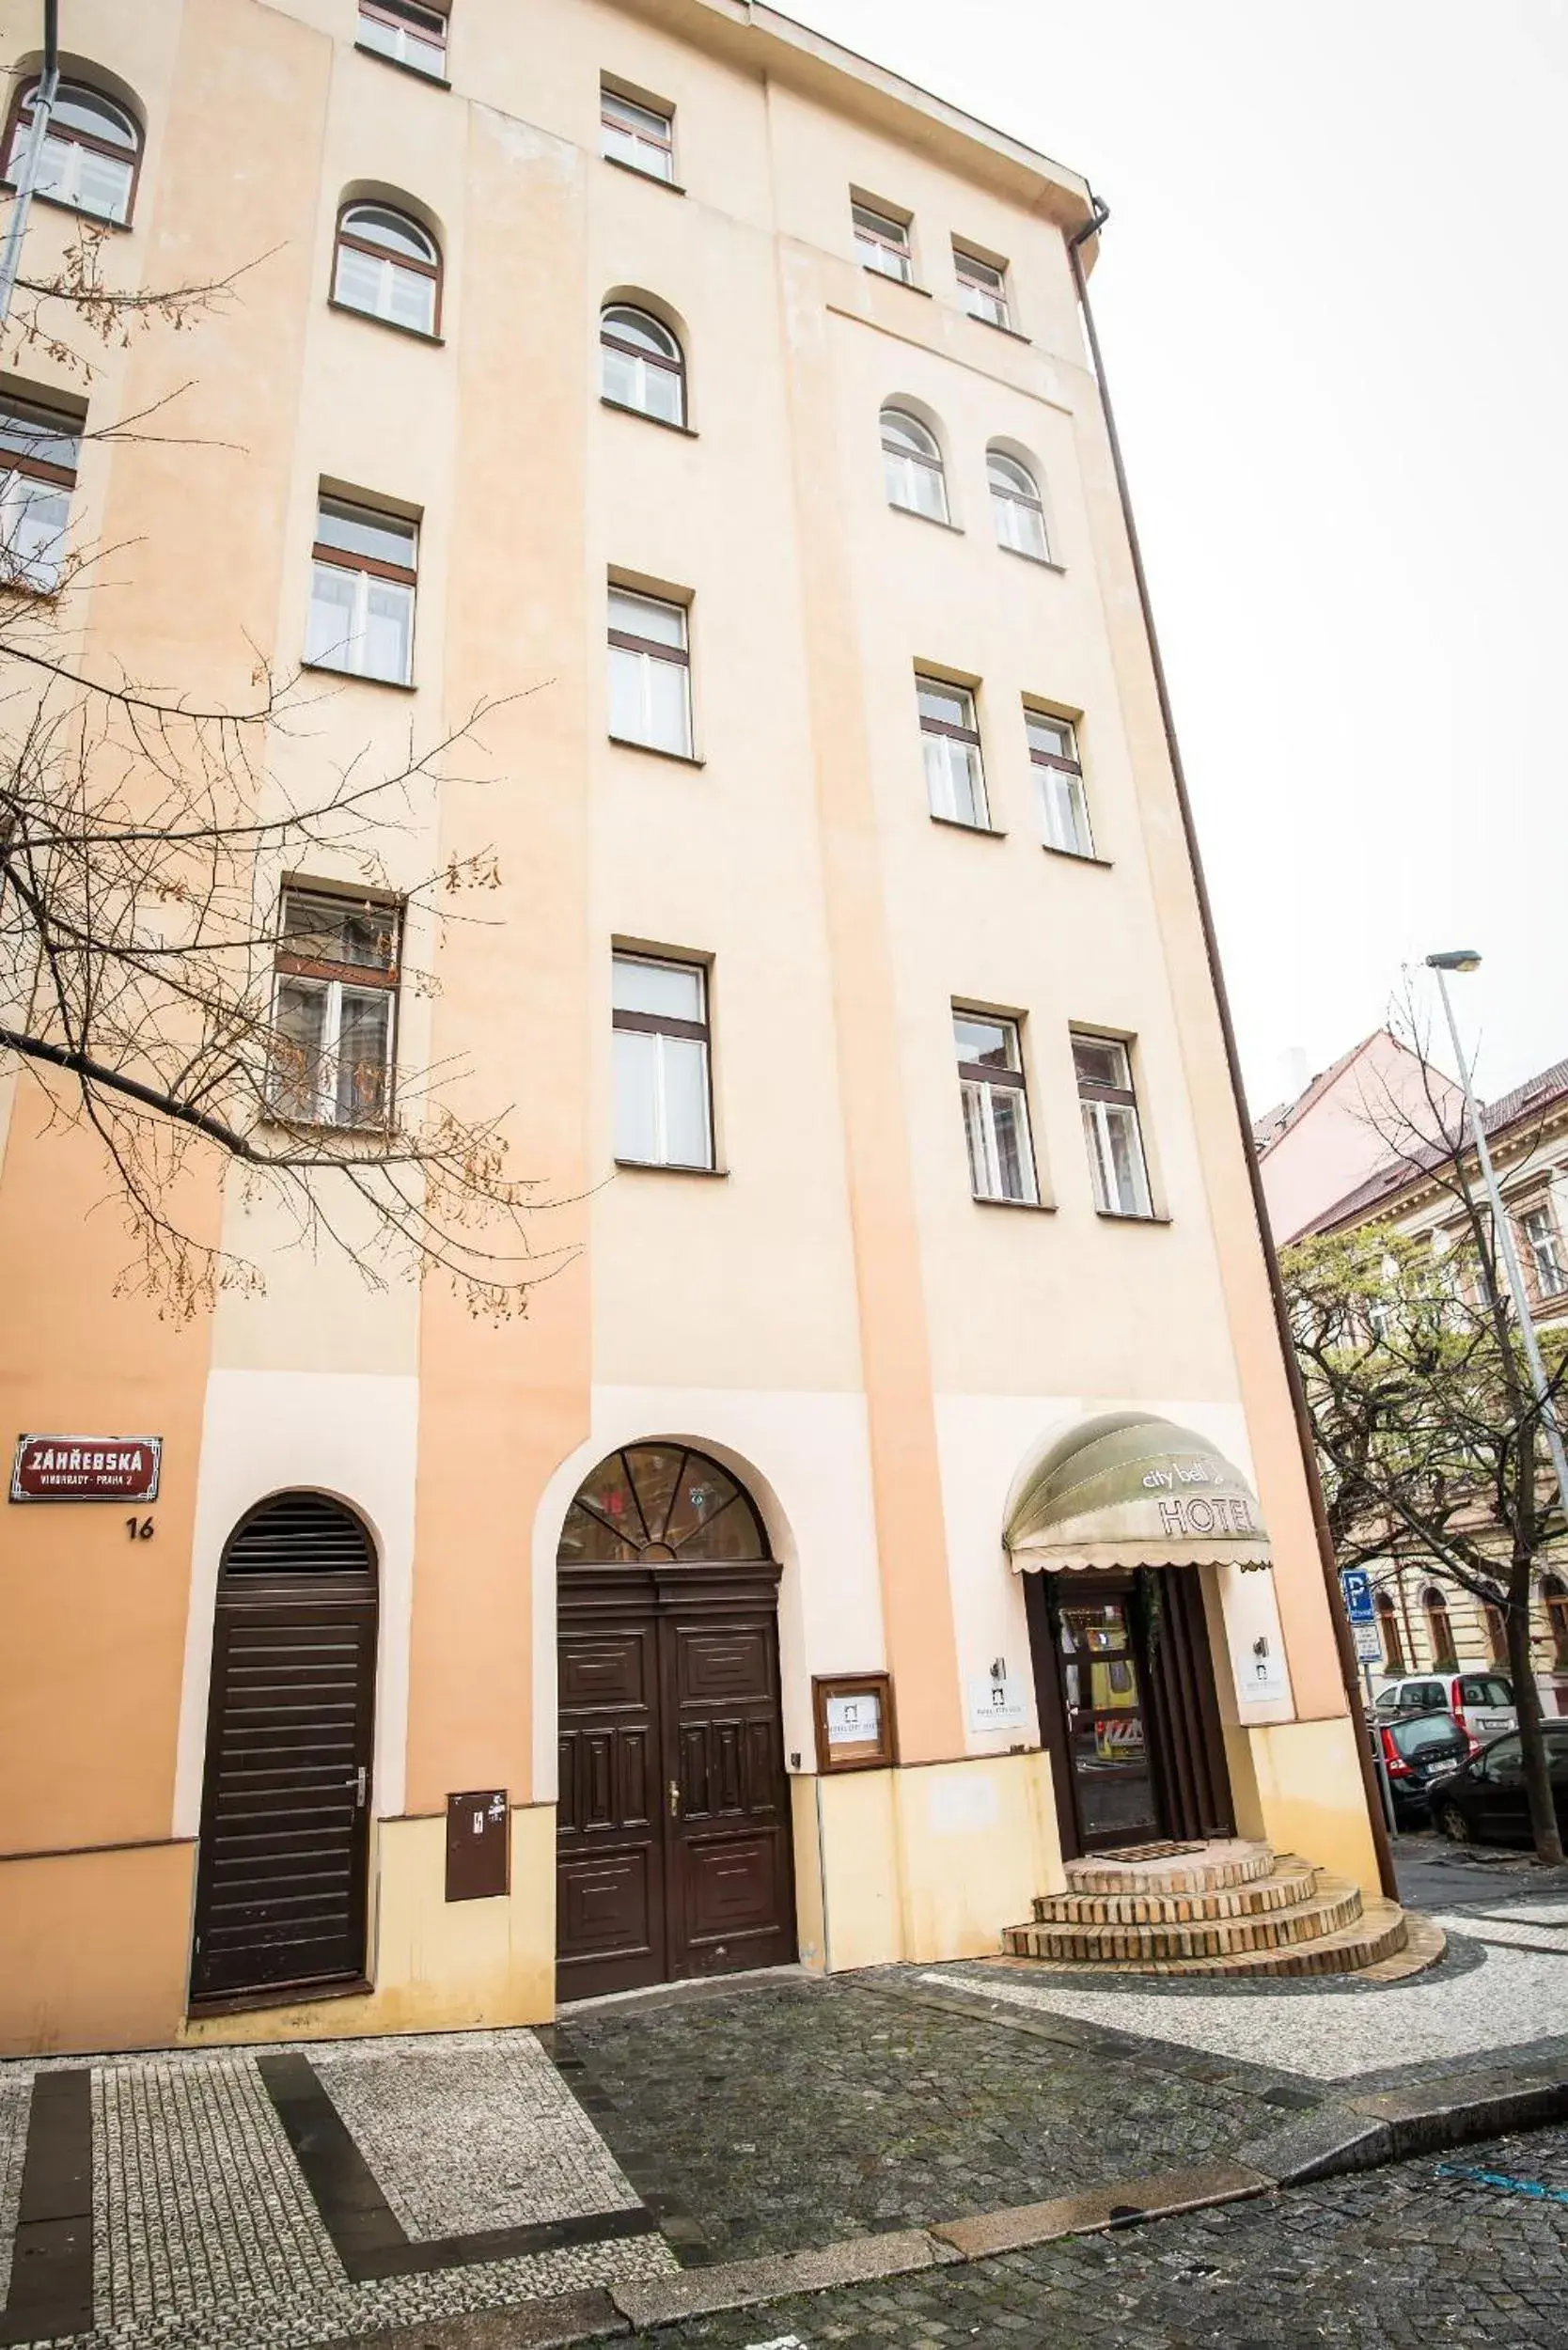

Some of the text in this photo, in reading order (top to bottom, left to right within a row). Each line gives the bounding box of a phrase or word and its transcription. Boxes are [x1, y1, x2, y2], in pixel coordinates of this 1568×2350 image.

[32, 1449, 143, 1472] ZÁHŘEBSKÁ
[96, 1474, 123, 1486] PRAHA
[126, 1475, 133, 1486] 2
[1142, 1461, 1210, 1489] city bell
[126, 1516, 154, 1541] 16
[1158, 1498, 1257, 1536] HOTEL
[1348, 1576, 1366, 1607] P
